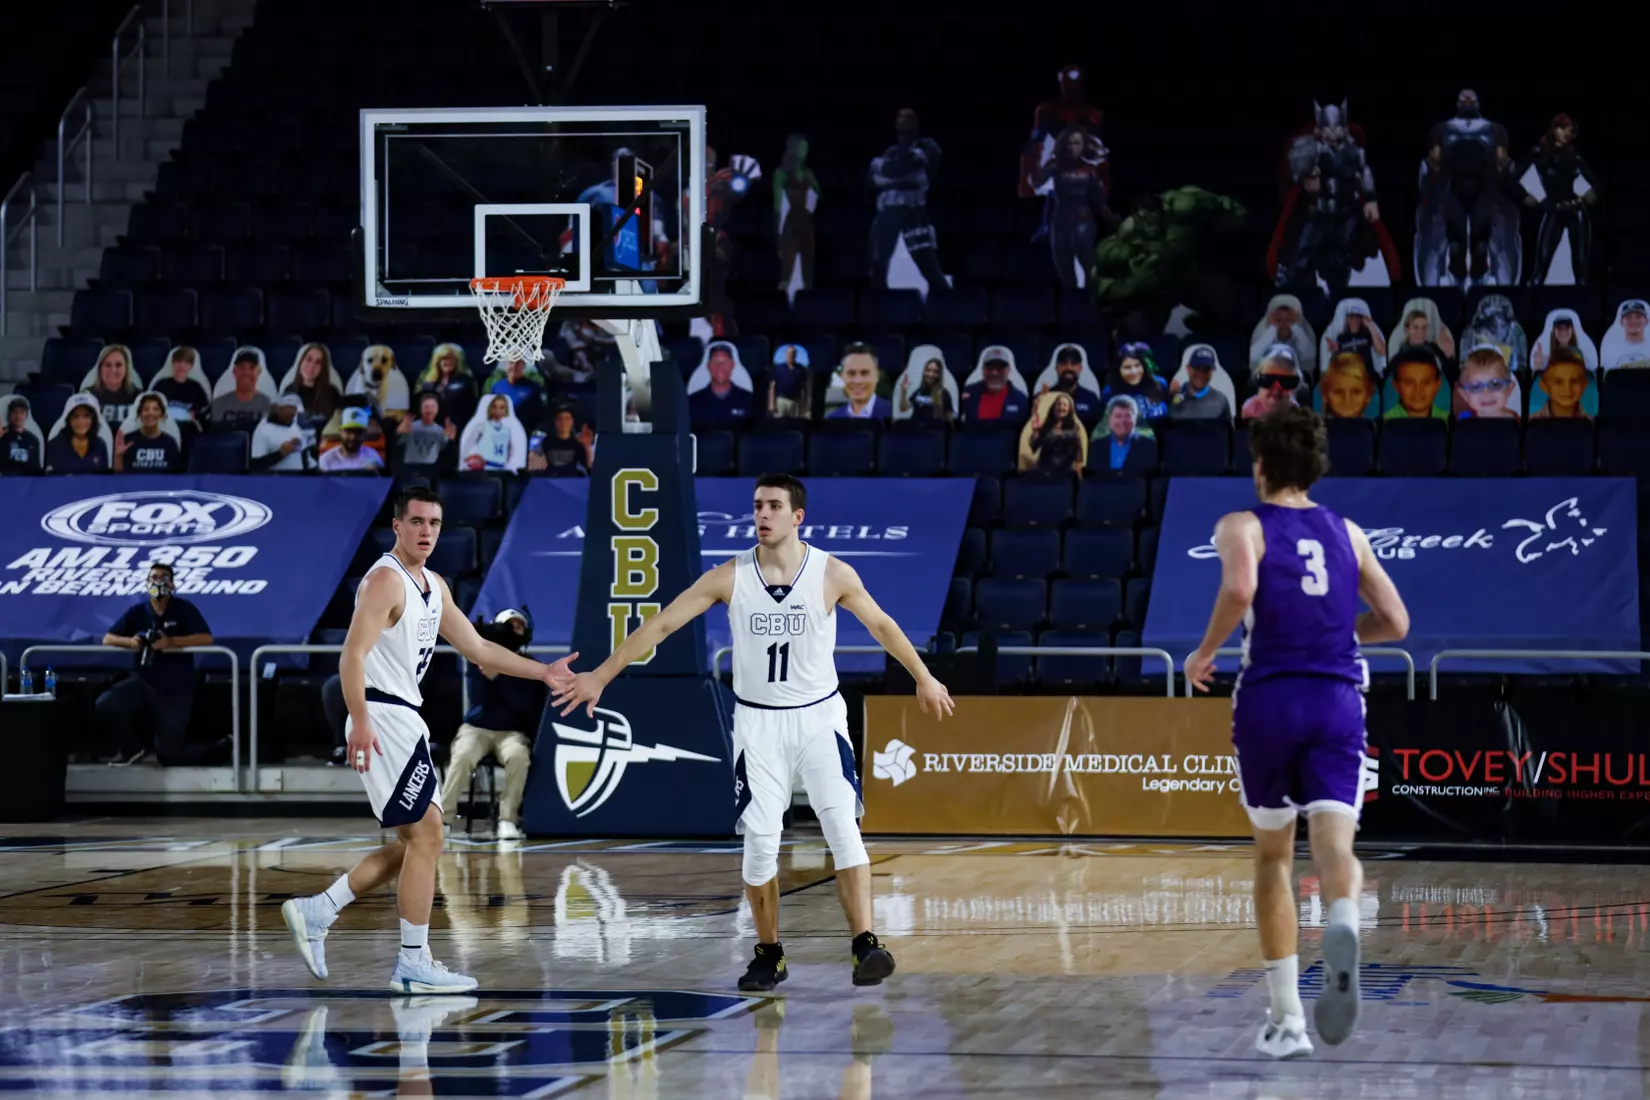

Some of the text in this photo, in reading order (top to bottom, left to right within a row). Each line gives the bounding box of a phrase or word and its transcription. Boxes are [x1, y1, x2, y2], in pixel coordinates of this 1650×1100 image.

[376, 298, 409, 306] SPALDING
[136, 448, 165, 461] CBU
[92, 501, 225, 524] FOX
[87, 522, 216, 535] SPORTS
[723, 524, 909, 540] HTELS
[607, 468, 661, 665] CBU
[1296, 538, 1329, 596] 3
[750, 612, 806, 636] CBU
[767, 641, 790, 683] 11
[922, 753, 1239, 775] RIVERSIDE MEDICAL CLIN
[399, 759, 430, 812] LANCERS
[1142, 777, 1226, 795] Legendary
[1504, 787, 1563, 799] BUILDING
[1567, 789, 1615, 800] HIGHER
